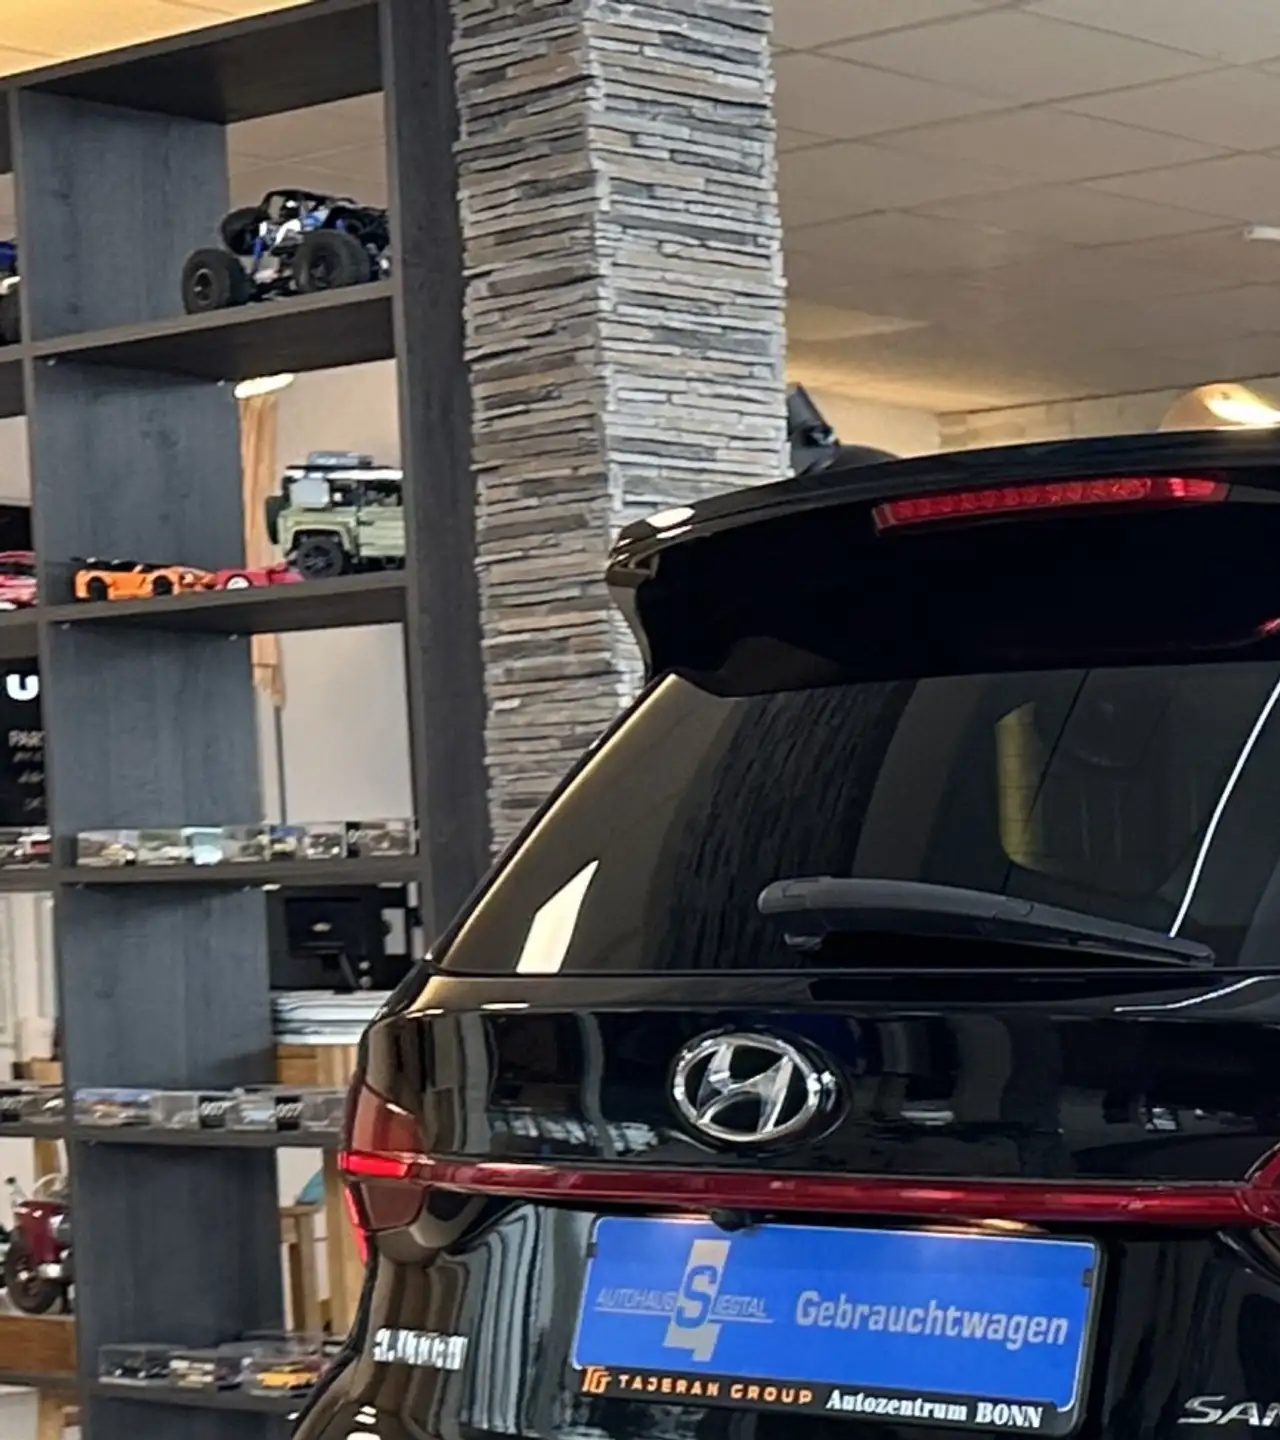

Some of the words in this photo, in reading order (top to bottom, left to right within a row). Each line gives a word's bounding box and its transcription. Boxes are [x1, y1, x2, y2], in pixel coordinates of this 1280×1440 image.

[596, 1287, 677, 1311] AUTOHAUS
[795, 1289, 1069, 1350] Gebrauchtwagen
[729, 1383, 814, 1404] GROUP
[826, 1388, 968, 1422] Autozentrum
[974, 1401, 1044, 1428] BONN
